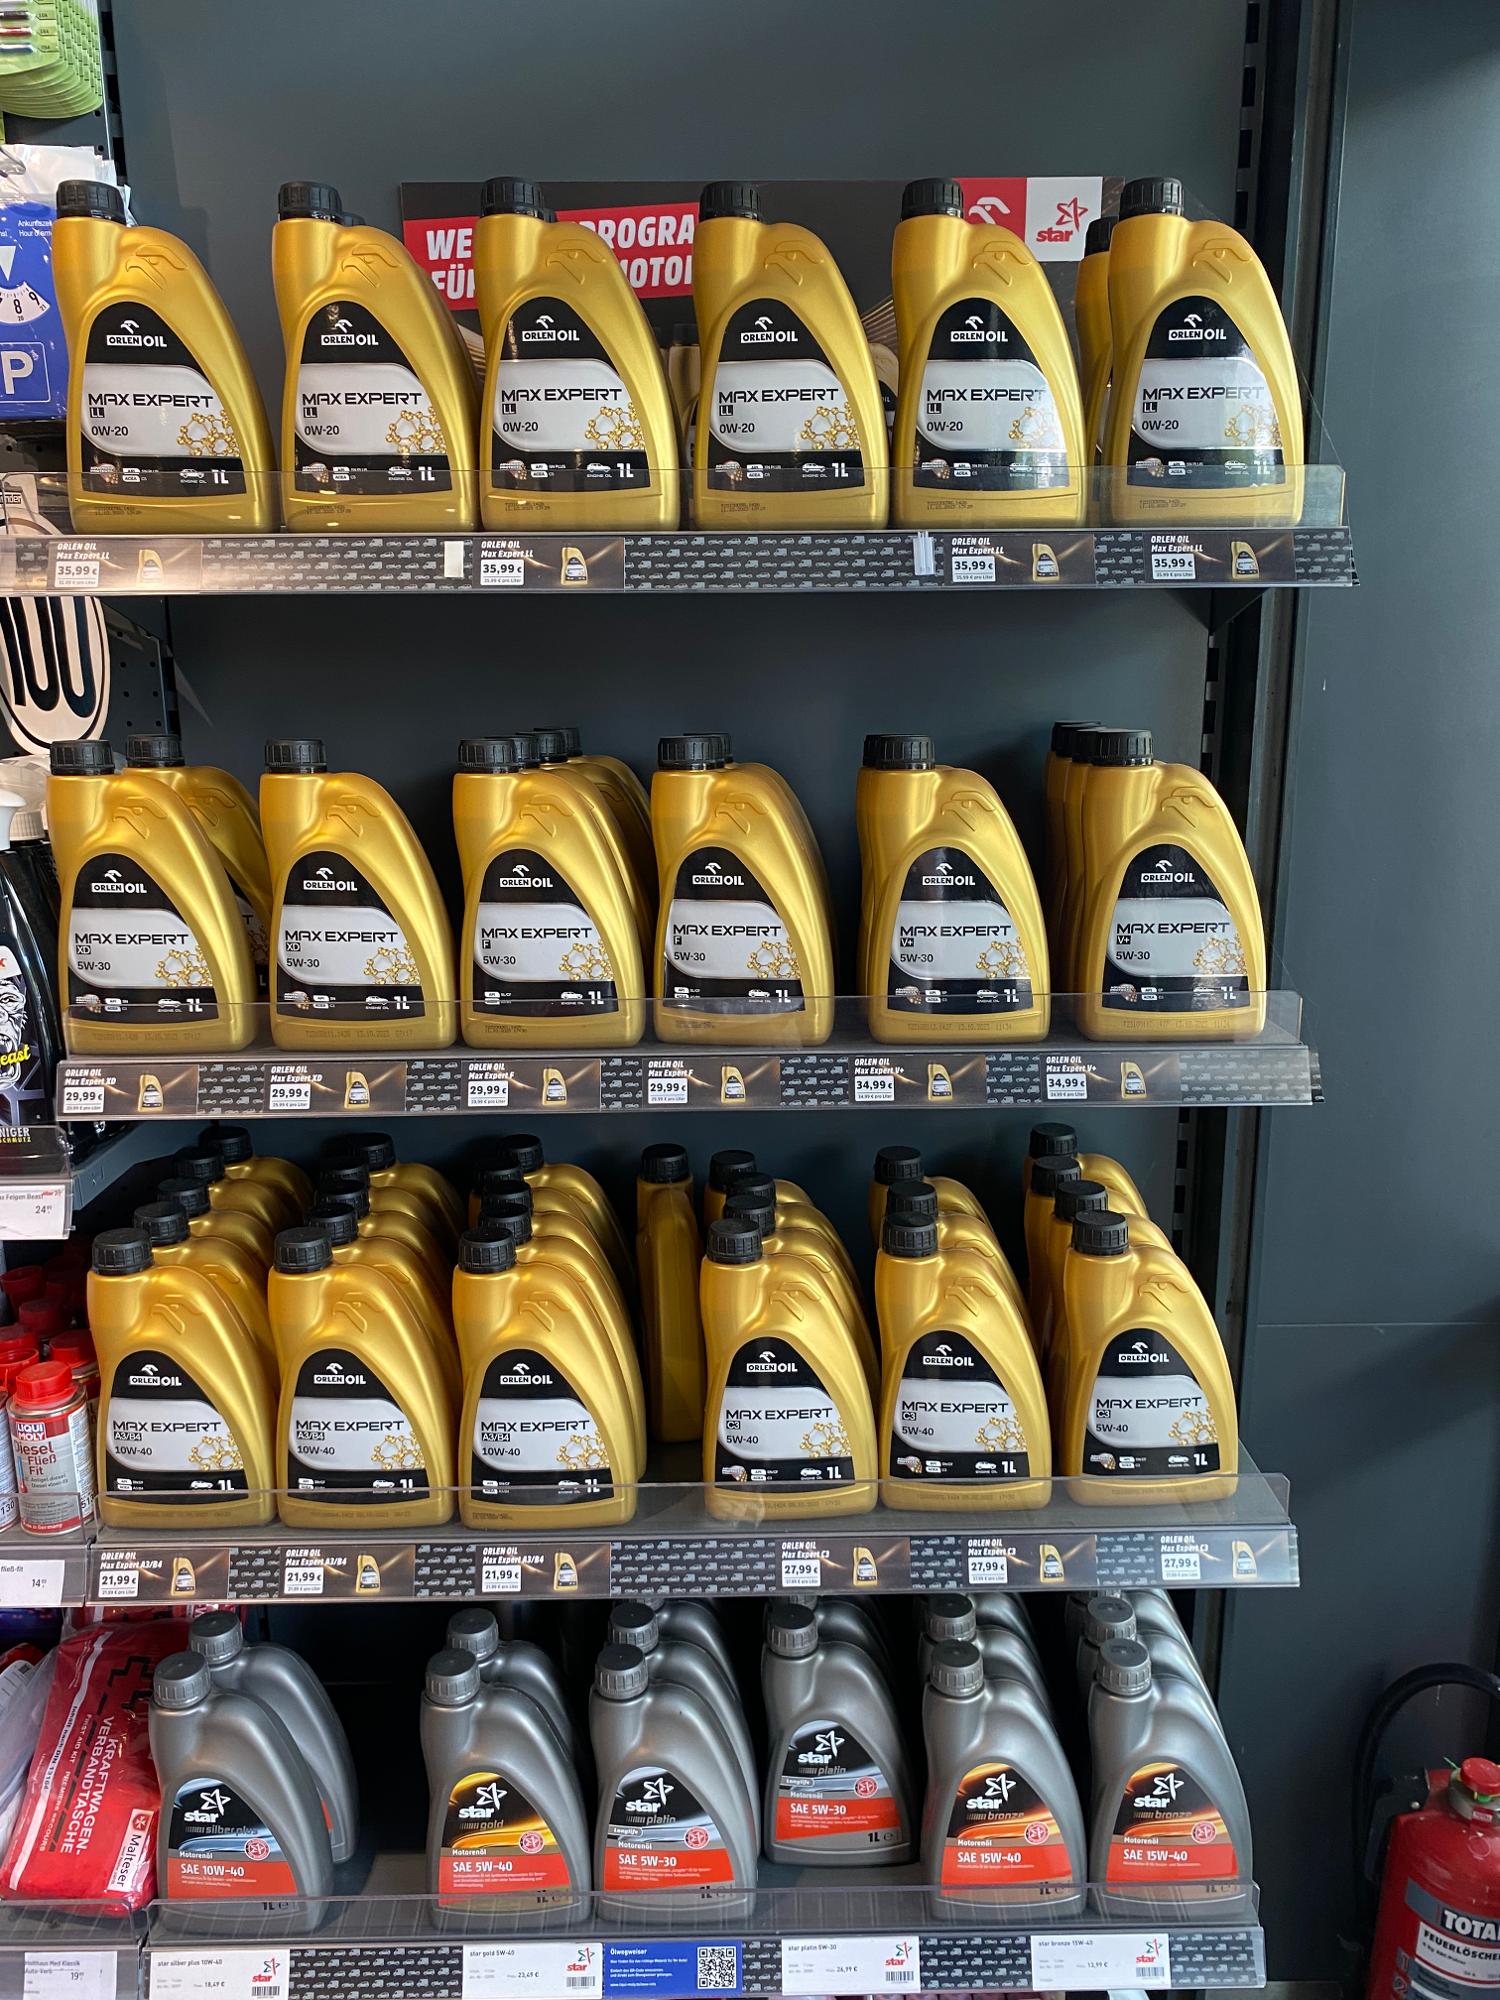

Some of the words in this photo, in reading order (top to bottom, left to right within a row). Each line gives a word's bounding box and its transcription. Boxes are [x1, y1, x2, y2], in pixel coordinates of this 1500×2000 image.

[1036, 227, 1073, 243] star
[431, 264, 475, 299] FÜ
[29, 291, 40, 306] 9
[14, 299, 22, 314] 8
[109, 336, 140, 345] ORLEN
[143, 337, 167, 348] OIL
[742, 333, 773, 342] ORLEN
[775, 331, 798, 342] OIL
[1, 351, 33, 395] P
[302, 393, 342, 405] MAX
[345, 392, 422, 405] EXPERT
[501, 389, 540, 402] MAX
[544, 389, 622, 401] EXPERT
[719, 390, 759, 403] MAX
[761, 389, 838, 401] EXPERT
[927, 389, 968, 401] MAX
[970, 389, 1046, 401] EXPERT
[1142, 388, 1184, 400] MAX
[1187, 387, 1264, 399] EXPERT
[88, 393, 129, 406] MAX
[133, 394, 213, 408] EXPERT
[502, 404, 516, 414] LL
[91, 426, 129, 436] 0W-20
[304, 425, 339, 435] 0W-20
[502, 421, 539, 432] 0W-20
[720, 423, 755, 434] 0W-20
[927, 421, 963, 432] 0W-20
[1142, 420, 1179, 431] 0W-20
[212, 470, 229, 484] 1L
[952, 538, 976, 546] ORLEN
[977, 538, 990, 546] OIL
[483, 564, 515, 574] 35,99
[955, 560, 986, 571] 35,99
[93, 884, 123, 892] ORLEN
[125, 883, 147, 893] OIL
[481, 928, 518, 939] MAX
[521, 928, 592, 938] EXPERT
[673, 925, 709, 936] MAX
[712, 925, 781, 936] EXPERT
[900, 926, 937, 937] MAX
[940, 925, 1012, 936] EXPERT
[1117, 923, 1155, 933] MAX
[1158, 922, 1230, 934] EXPERT
[75, 934, 112, 944] MAX
[116, 934, 189, 944] EXPERT
[285, 931, 322, 942] MAX
[325, 931, 398, 942] EXPERT
[286, 942, 300, 952] XD
[900, 938, 914, 947] V+
[483, 956, 516, 965] 5W-30
[674, 952, 706, 962] 5W-30
[900, 953, 934, 963] 5W-30
[1116, 951, 1150, 960] 5W-30
[78, 962, 111, 971] 5W-30
[287, 958, 320, 968] 5W-30
[470, 1086, 500, 1095] 29,99
[856, 1080, 886, 1090] 34,99
[65, 1091, 96, 1101] 29,99
[748, 1364, 775, 1372] ORLEN
[777, 1362, 798, 1373] OIL
[902, 1402, 938, 1412] MAX
[940, 1403, 1008, 1413] EXPERT
[1096, 1398, 1132, 1408] MAX
[1135, 1397, 1201, 1408] EXPERT
[726, 1409, 761, 1420] MAX
[765, 1408, 833, 1419] EXPERT
[902, 1412, 916, 1421] C3
[17, 1424, 44, 1432] LIQUI
[113, 1421, 148, 1432] MAX
[152, 1421, 221, 1432] EXPERT
[296, 1420, 331, 1431] MAX
[335, 1420, 404, 1432] EXPERT
[481, 1421, 517, 1432] MAX
[521, 1420, 590, 1431] EXPERT
[902, 1426, 934, 1436] 5W-40
[1096, 1424, 1129, 1433] 5W-40
[726, 1435, 759, 1444] 5W-40
[14, 1441, 54, 1455] Diesel
[116, 1446, 152, 1455] 10W-40
[298, 1446, 335, 1455] 10W-40
[482, 1448, 520, 1456] 10W-40
[28, 1454, 56, 1465] Fließ
[29, 1466, 44, 1475] Fit
[1001, 1461, 1017, 1474] 1L
[784, 1565, 811, 1574] 27,99
[288, 1572, 315, 1582] 21,99
[798, 1752, 832, 1764] star
[61, 1716, 115, 1854] VERBANDTASCHE
[76, 1738, 119, 1856] KRAFTWAGEN-
[1134, 1796, 1170, 1808] star
[626, 1799, 661, 1813] star
[790, 1803, 809, 1814] SAE
[812, 1804, 846, 1814] 5W-30
[966, 1798, 1002, 1809] star
[184, 1811, 219, 1823] star
[458, 1806, 495, 1819] star
[867, 1832, 880, 1842] 1L
[957, 1839, 992, 1847] Motorenöl
[116, 1834, 141, 1887] Malteser
[179, 1851, 212, 1859] Motorenöl
[619, 1854, 638, 1866] SAE
[640, 1855, 677, 1867] 5W-30
[957, 1852, 977, 1863] SAE
[980, 1852, 1022, 1863] 15W-40
[1123, 1849, 1143, 1861] SAE
[1146, 1850, 1188, 1861] 15W-40
[181, 1864, 199, 1875] SAE
[202, 1865, 245, 1877] 10W-40
[453, 1860, 472, 1873] SAE
[475, 1860, 513, 1873] 5W-40
[1443, 1909, 1500, 1942] TOTA
[1423, 1929, 1500, 1961] FEUERLÖSCHE
[610, 1947, 647, 1956] Ölwegweiser
[885, 1958, 905, 1966] star
[1135, 1955, 1155, 1963] star
[566, 1963, 587, 1971] star
[252, 1974, 272, 1982] star
